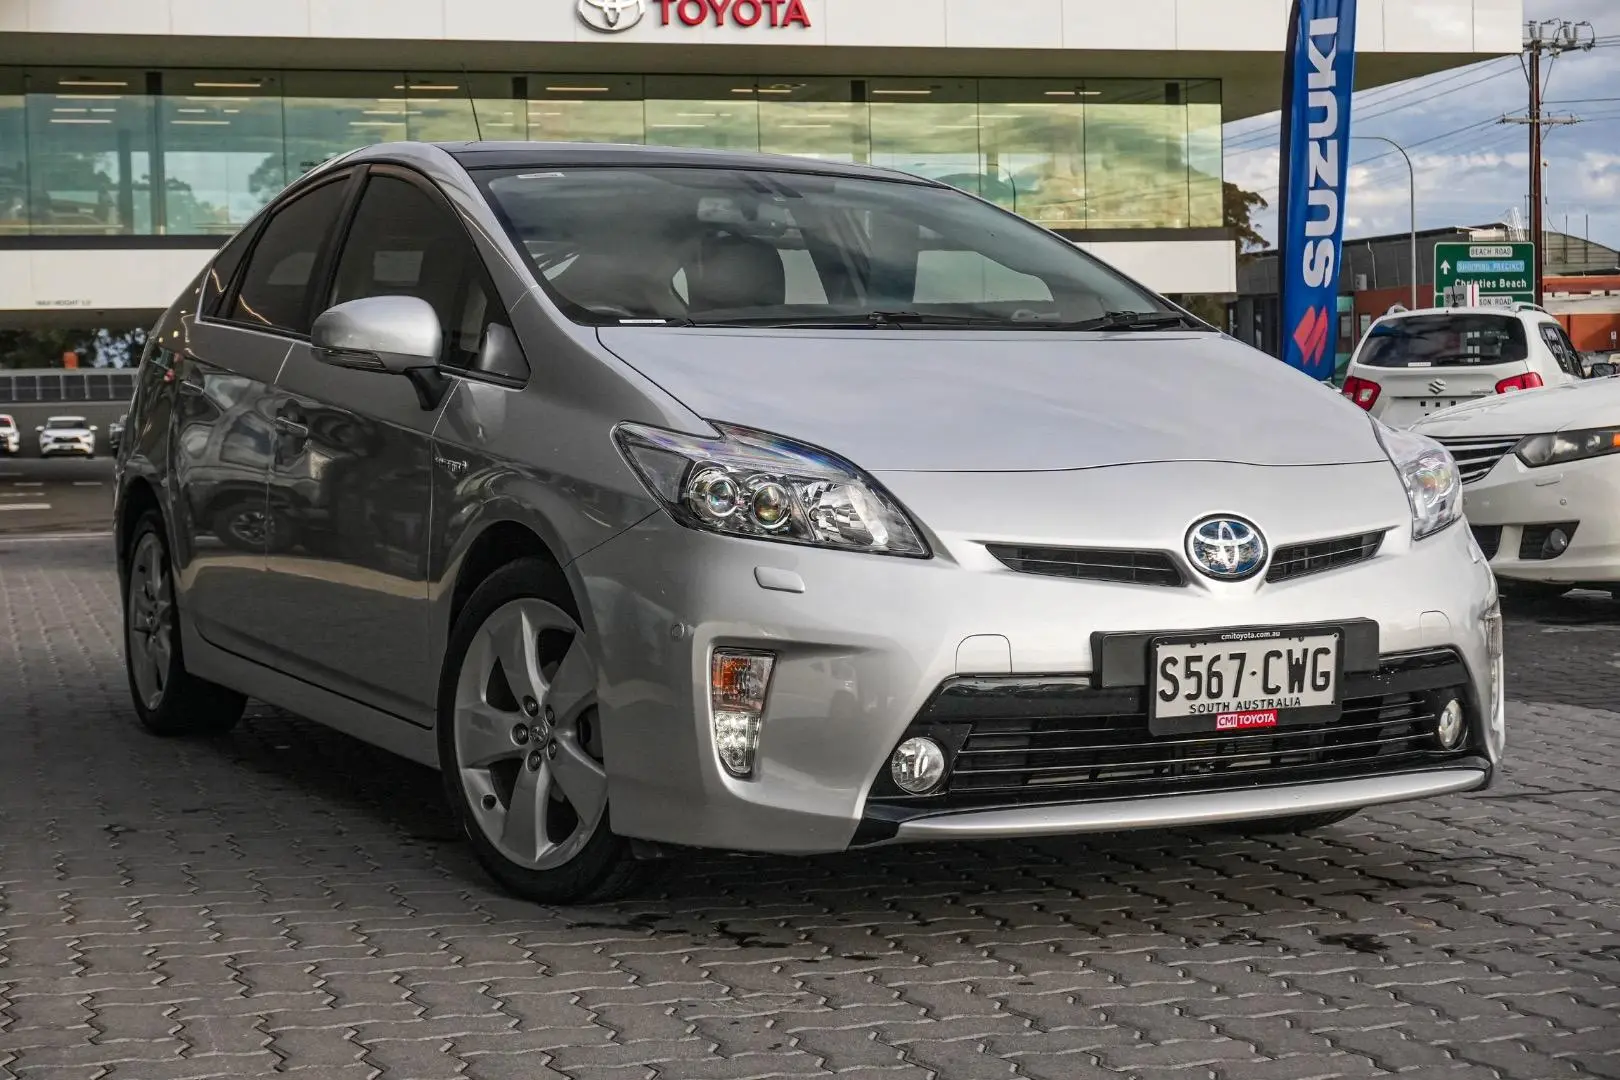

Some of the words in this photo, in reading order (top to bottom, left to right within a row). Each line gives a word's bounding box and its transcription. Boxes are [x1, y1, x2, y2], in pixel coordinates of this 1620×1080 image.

[653, 0, 811, 27] TOYOTA
[1303, 17, 1338, 288] SUZUKI
[1471, 248, 1491, 256] BEACH
[1495, 247, 1512, 256] ROAD
[1499, 279, 1527, 288] Beach
[1495, 297, 1512, 306] ROAD
[1221, 631, 1281, 641] cmitoyota.com.au
[1189, 701, 1230, 714] SOUTH
[1236, 697, 1301, 711] AUSTRALIA
[1218, 715, 1237, 727] CMI
[1239, 713, 1275, 725] TOYOTA
